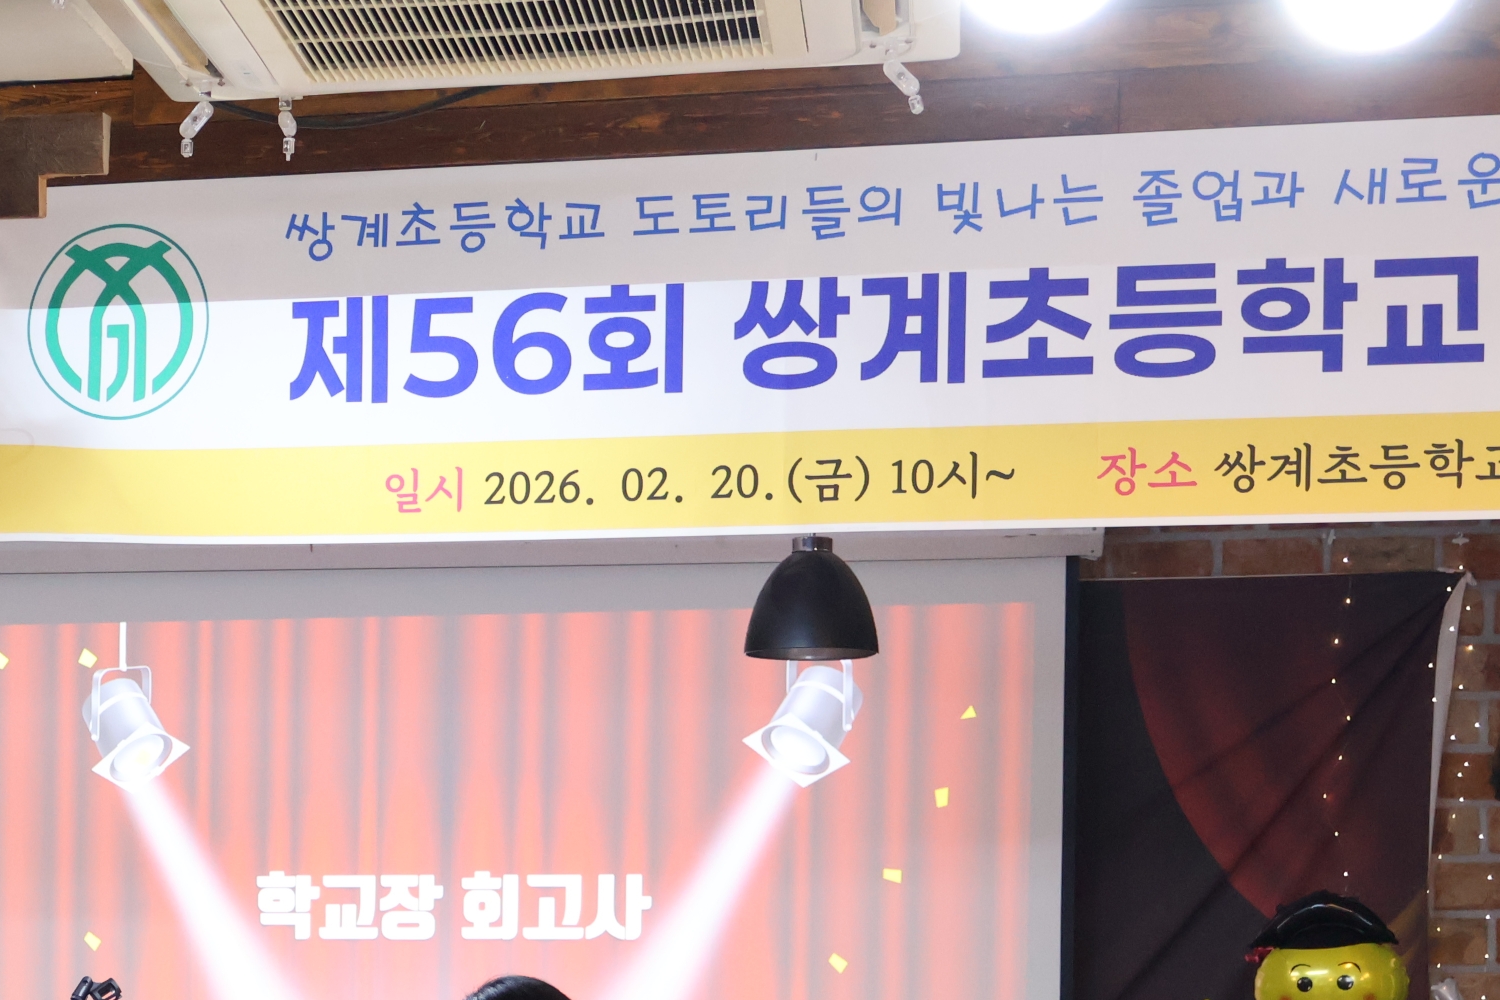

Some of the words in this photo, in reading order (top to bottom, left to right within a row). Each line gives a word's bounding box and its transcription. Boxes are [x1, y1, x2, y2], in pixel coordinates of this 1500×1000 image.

[285, 198, 605, 262] 쌍계초등학교
[633, 185, 902, 241] 도토리들의
[937, 173, 1104, 235] 빛나는
[1133, 169, 1305, 227] 졸업과
[1334, 152, 1500, 209] 새로운
[289, 283, 685, 404] 제56회
[733, 256, 1484, 391] 쌍계초등학교
[385, 467, 463, 513] 일시
[484, 469, 594, 506] 2026.
[621, 467, 683, 503] 02.
[710, 455, 870, 504] 20.(금)
[891, 451, 1015, 500] 10시~
[1097, 446, 1198, 497] 장소
[256, 870, 444, 941] 학교장
[460, 870, 652, 941] 회고사
